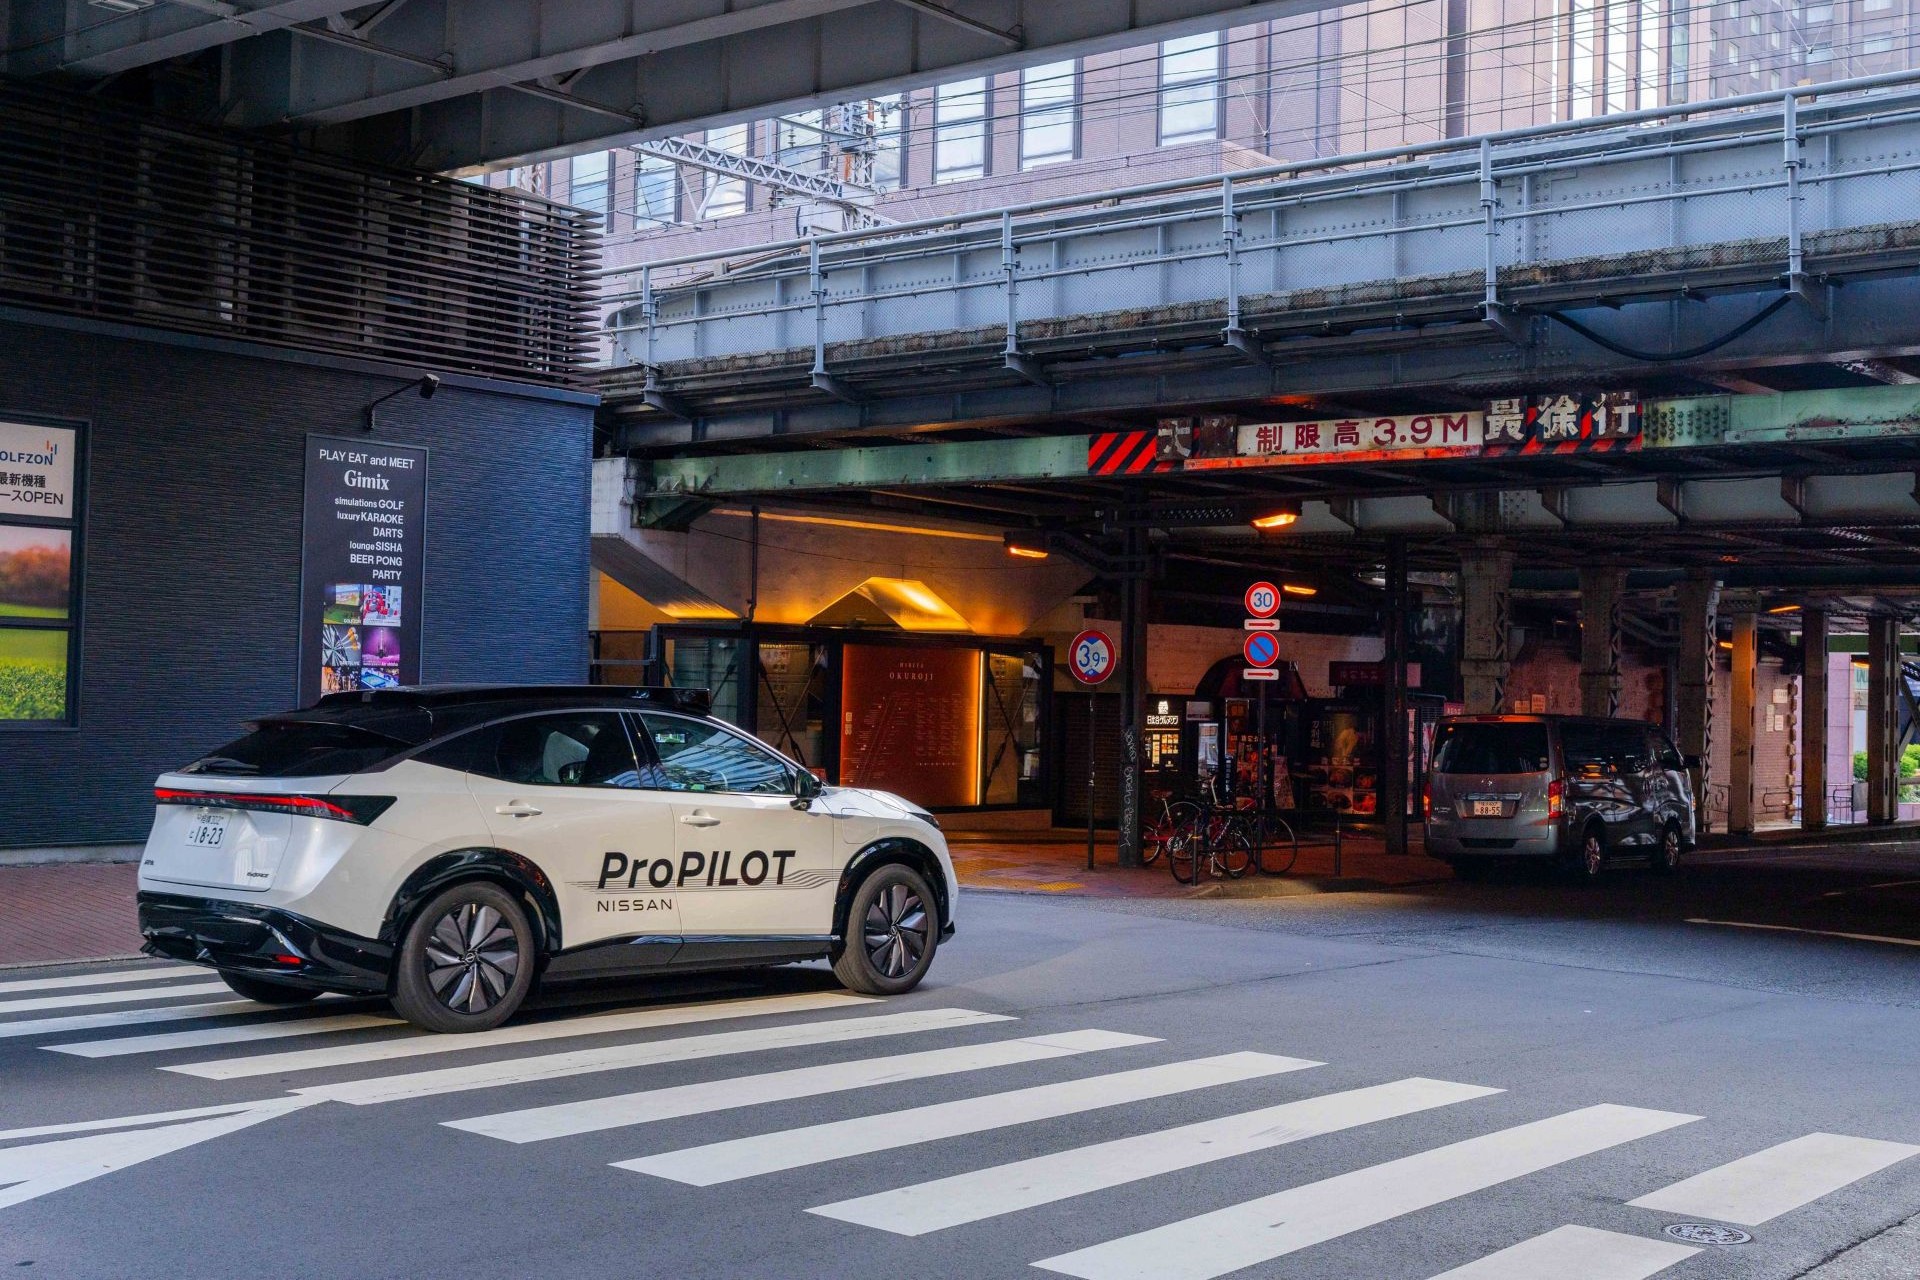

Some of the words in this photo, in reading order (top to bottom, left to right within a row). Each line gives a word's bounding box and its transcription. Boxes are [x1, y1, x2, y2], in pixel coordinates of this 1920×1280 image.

[319, 449, 346, 461] PLAY
[348, 452, 368, 464] EAT
[370, 456, 387, 466] and
[389, 457, 415, 469] MEET
[343, 469, 390, 491] Gimix
[334, 497, 377, 508] simulations
[378, 499, 405, 510] GOLF
[337, 511, 360, 522] luxury
[360, 511, 404, 525] KARAOKE
[373, 527, 403, 539] DARTS
[349, 541, 375, 551] lounge
[375, 541, 403, 552] SISHA
[350, 553, 374, 565] BEER
[376, 555, 403, 567] PONG
[372, 569, 402, 580] PARTY
[1253, 592, 1273, 608] 30
[889, 671, 934, 681] OKUROJI
[597, 850, 796, 889] ProPILOT
[597, 898, 672, 912] NISSAN
